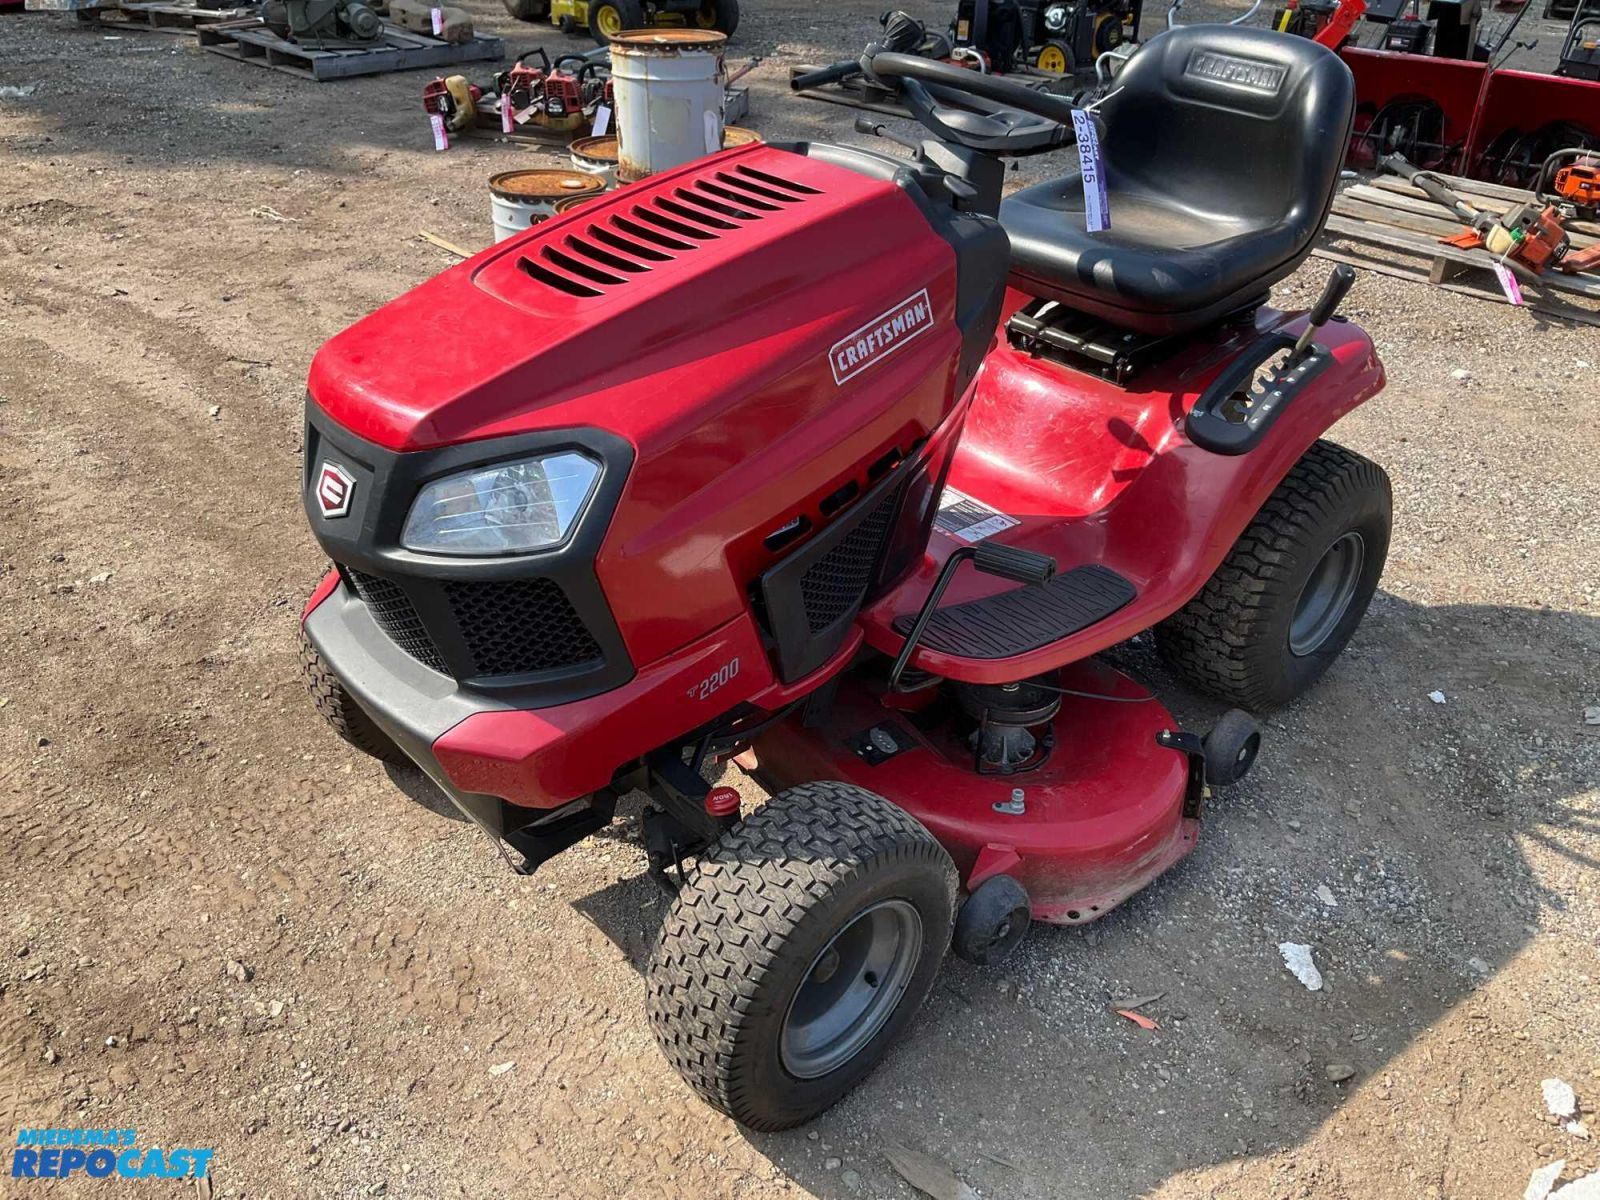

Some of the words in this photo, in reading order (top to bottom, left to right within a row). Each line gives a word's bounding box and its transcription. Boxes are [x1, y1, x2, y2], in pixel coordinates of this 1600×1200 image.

[1193, 55, 1281, 88] CRAFTSMAN
[1074, 115, 1095, 183] 2-38415
[837, 302, 926, 371] CRAFTSMAN
[687, 657, 739, 700] T2200
